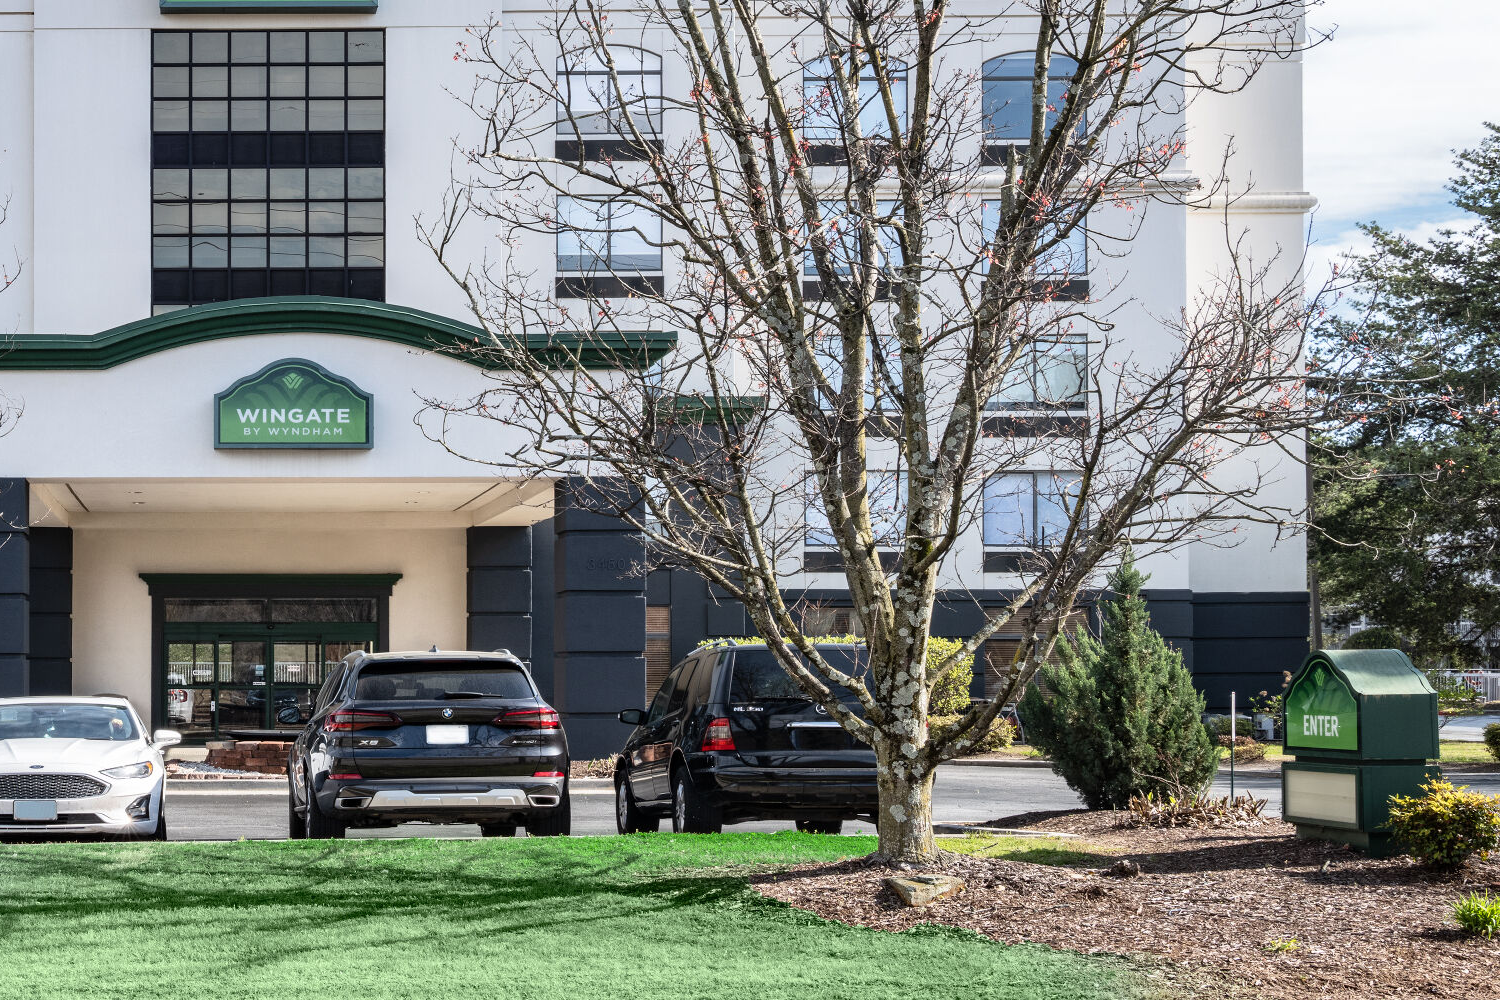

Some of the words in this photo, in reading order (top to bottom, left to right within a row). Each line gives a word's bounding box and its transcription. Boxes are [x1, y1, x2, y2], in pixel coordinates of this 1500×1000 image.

[236, 408, 350, 423] WINGATE
[243, 427, 261, 435] BY
[268, 427, 343, 435] WYNDHAM
[1303, 714, 1339, 737] ENTER
